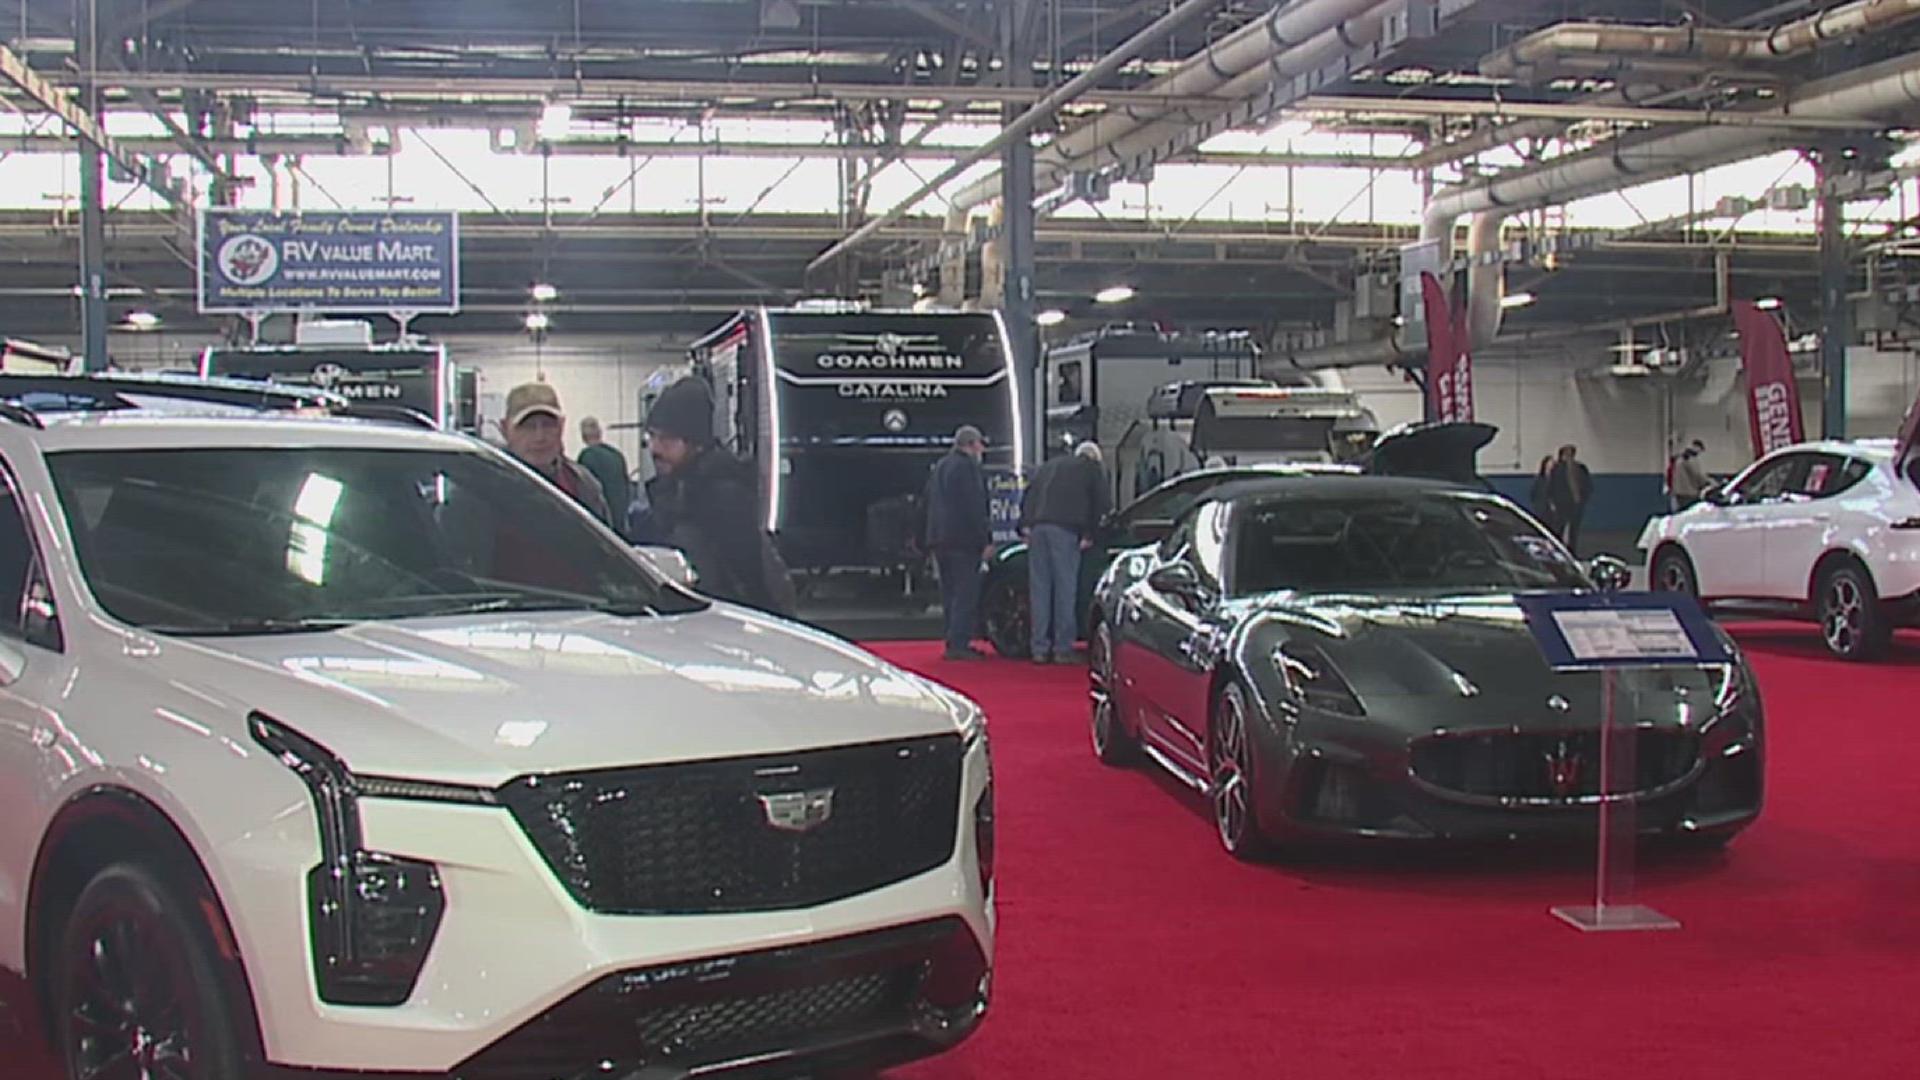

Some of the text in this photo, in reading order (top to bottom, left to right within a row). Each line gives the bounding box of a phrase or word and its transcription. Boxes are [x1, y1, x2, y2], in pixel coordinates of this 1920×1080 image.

[251, 219, 285, 233] Local
[289, 219, 334, 235] Family
[338, 218, 375, 233] Owned
[380, 218, 443, 235] Dealership
[283, 241, 317, 261] RV
[320, 244, 373, 261] VALUE
[219, 286, 265, 299] Multiple
[268, 286, 323, 298] Locations
[328, 286, 340, 298] To
[343, 286, 375, 298] Serve
[379, 286, 399, 298] You
[816, 354, 964, 369] COACHMEN
[335, 384, 402, 398] MEN
[837, 383, 948, 398] CATALINA
